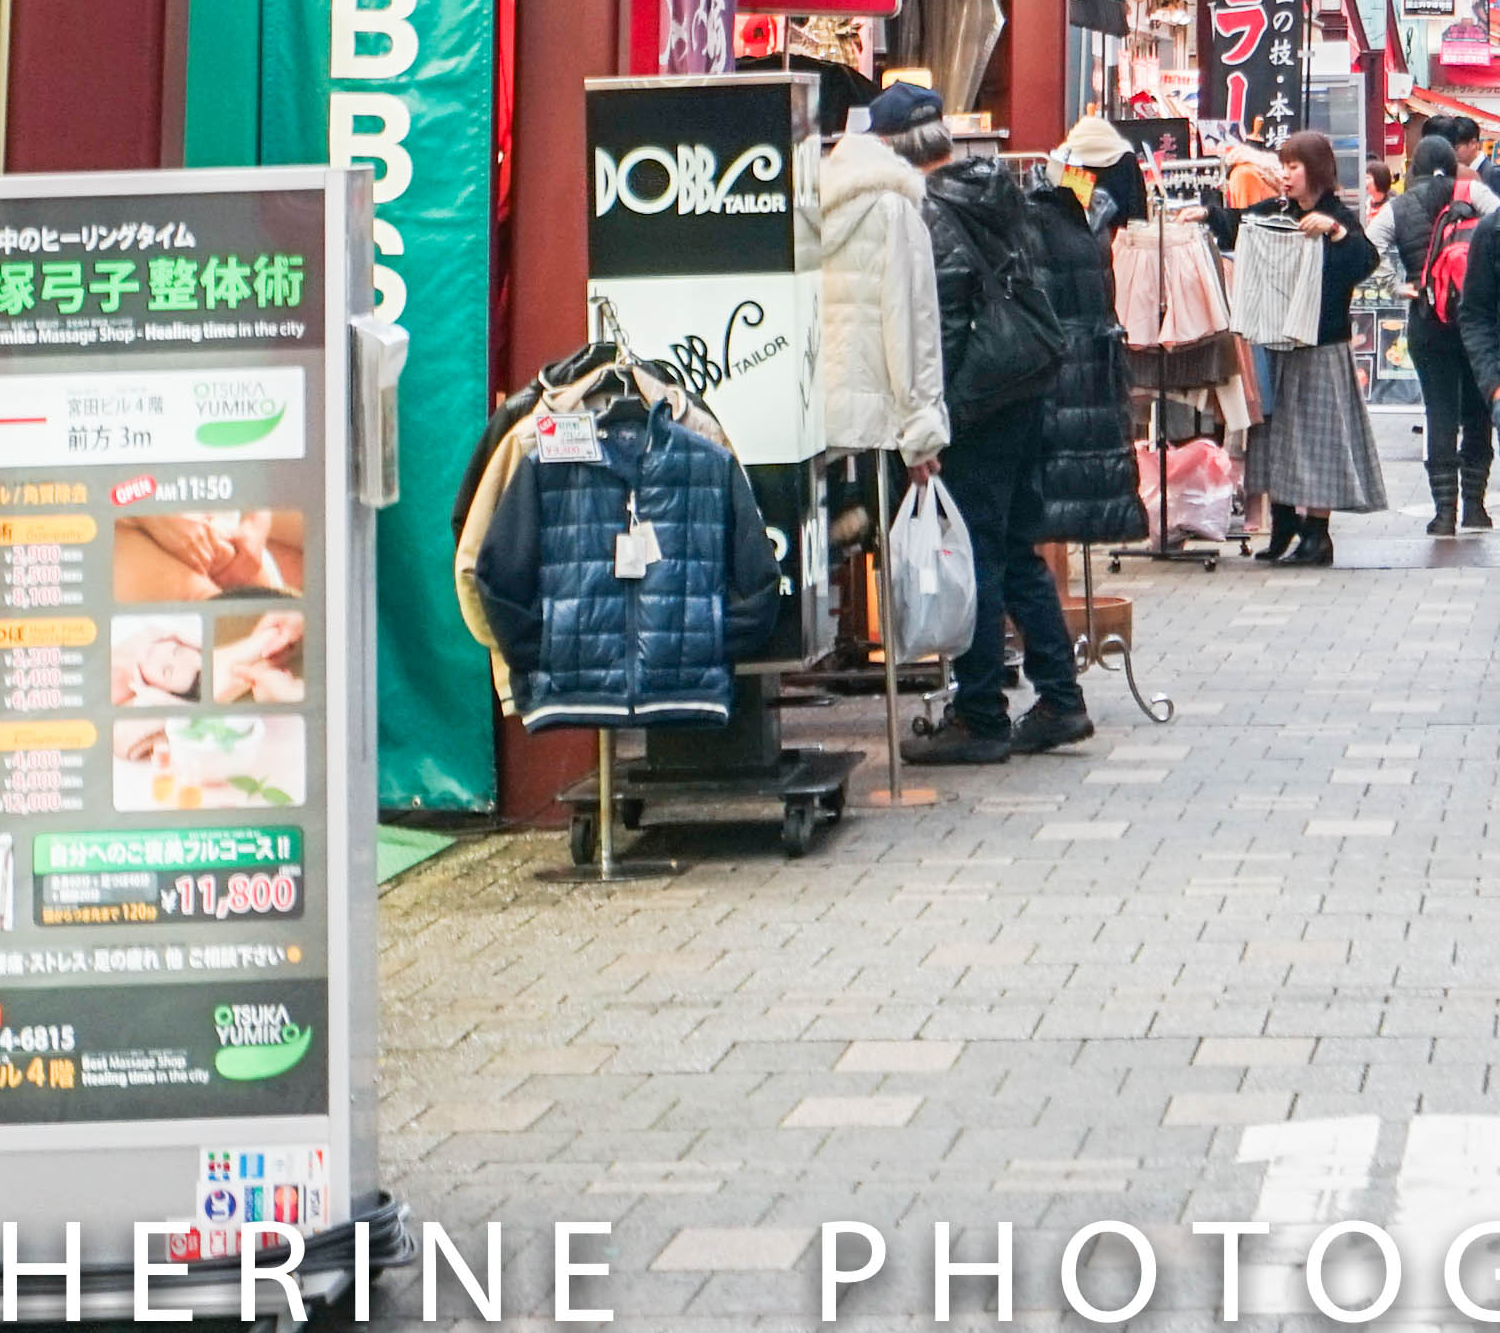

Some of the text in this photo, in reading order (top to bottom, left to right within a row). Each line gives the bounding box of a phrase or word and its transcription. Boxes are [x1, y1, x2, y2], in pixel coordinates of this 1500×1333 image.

[723, 193, 786, 214] TAILOR
[38, 326, 96, 348] Massage
[98, 325, 136, 346] Shop
[145, 322, 200, 345] Healing
[202, 321, 236, 340] time
[238, 322, 252, 339] in
[254, 321, 276, 338] the
[280, 320, 305, 342] city
[732, 334, 790, 376] TAILOR
[194, 381, 266, 399] OTSUKA
[196, 398, 276, 416] YUMIKO
[68, 424, 152, 452] 前方 3m
[116, 479, 152, 504] OPEN
[155, 475, 232, 503] AM11:50
[161, 874, 296, 919] ¥11,800
[214, 1004, 290, 1026] OTSUKA
[215, 1023, 301, 1047] YUMIKO
[82, 1054, 107, 1071] Best
[108, 1055, 157, 1072] Massage
